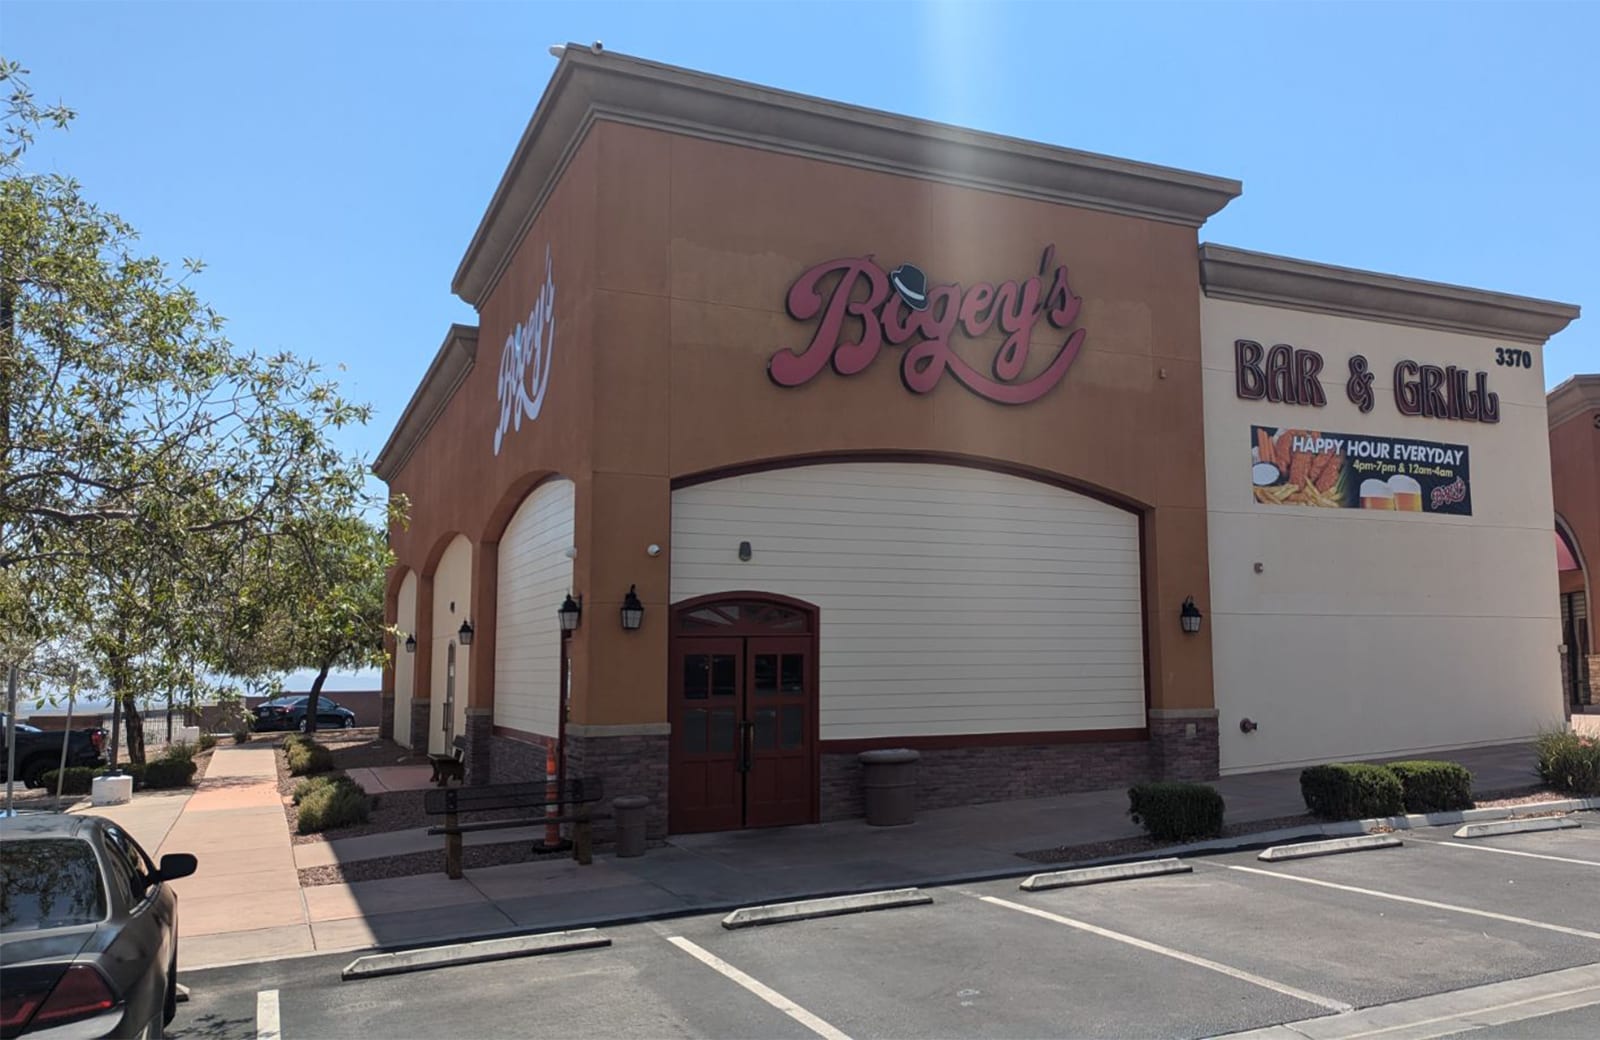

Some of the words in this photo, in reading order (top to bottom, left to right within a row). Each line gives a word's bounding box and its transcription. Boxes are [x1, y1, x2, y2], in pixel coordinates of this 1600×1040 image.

[768, 244, 1086, 405] Bogey's
[1494, 347, 1532, 369] 3370
[1235, 339, 1327, 407] BAR
[1346, 354, 1375, 413] &
[1393, 359, 1500, 424] GRILL
[1292, 436, 1344, 455] HAPPY
[1347, 441, 1390, 459] HOUR
[1393, 445, 1463, 466] EVERYDAY
[1353, 460, 1396, 473] 4pm-7pm
[1398, 464, 1405, 473] &
[1408, 463, 1453, 477] 12am-4am
